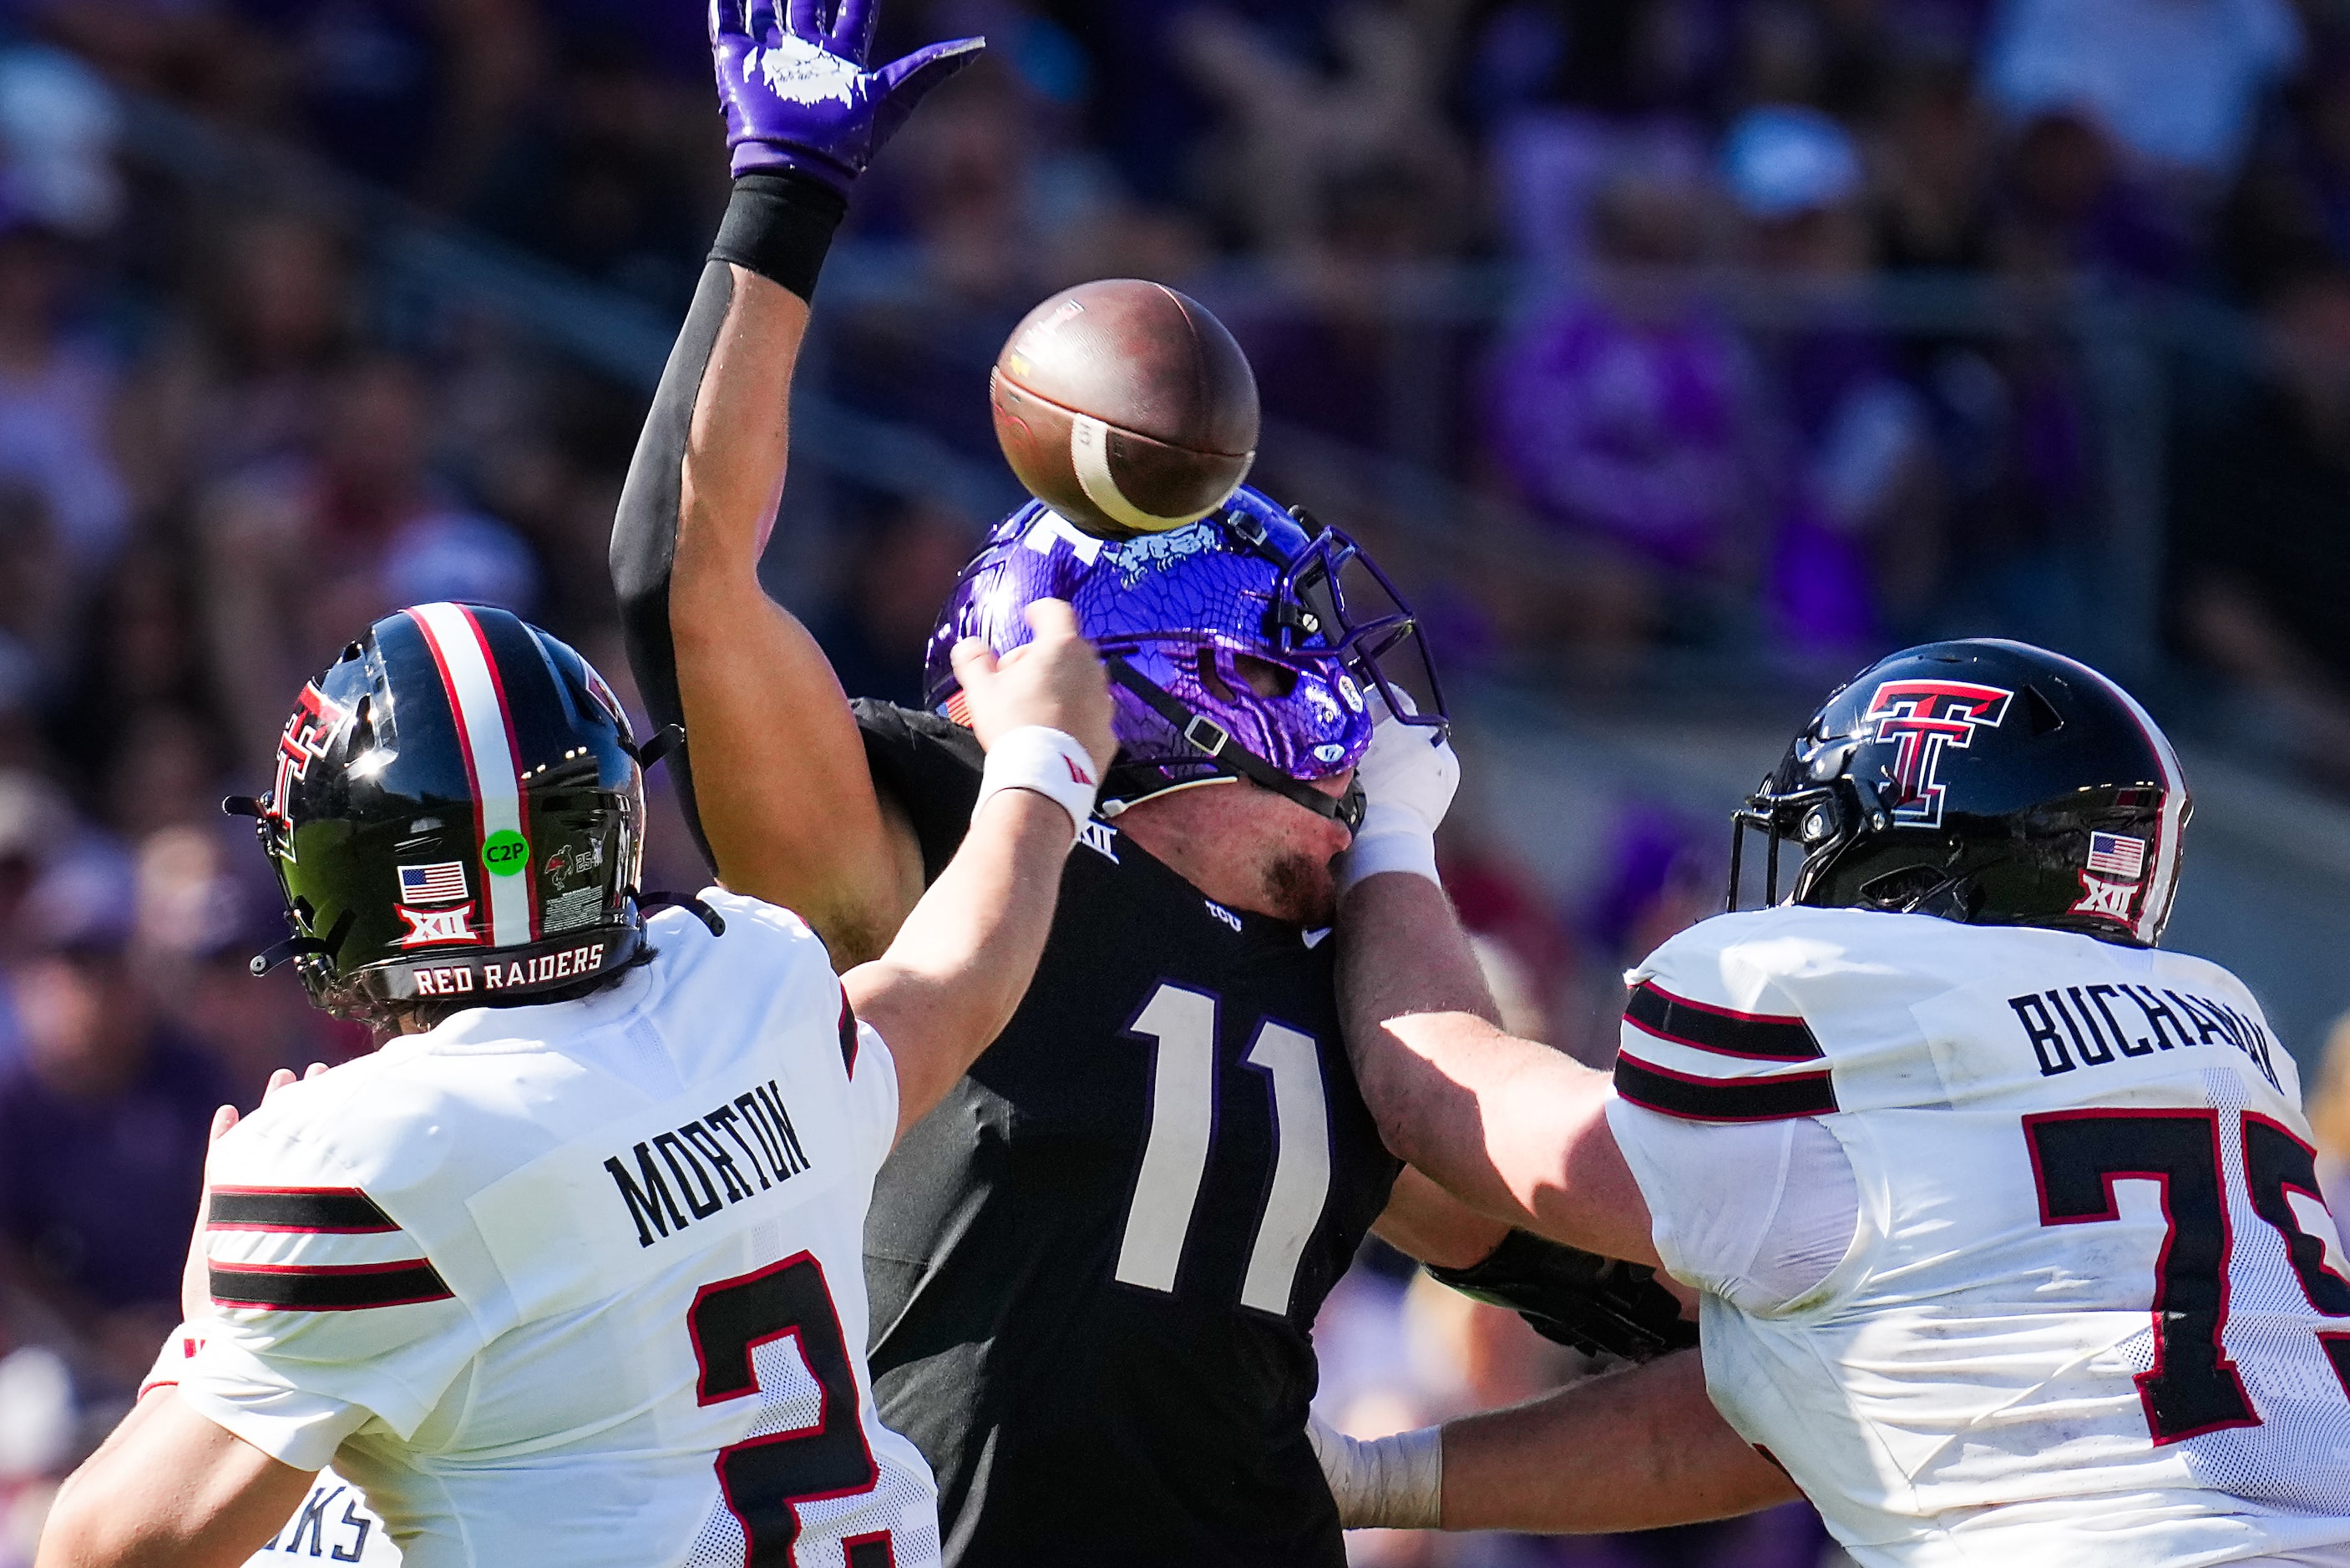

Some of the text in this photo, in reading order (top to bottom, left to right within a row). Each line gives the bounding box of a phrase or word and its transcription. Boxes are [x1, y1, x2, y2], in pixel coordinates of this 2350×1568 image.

[486, 842, 524, 862] C2P
[1204, 900, 1242, 933] TCU
[413, 943, 605, 995] RED RAIDERS
[603, 1080, 812, 1248] MORTON
[1112, 980, 1335, 1320] 11
[686, 1248, 880, 1568] 2
[264, 1485, 371, 1563] KS
